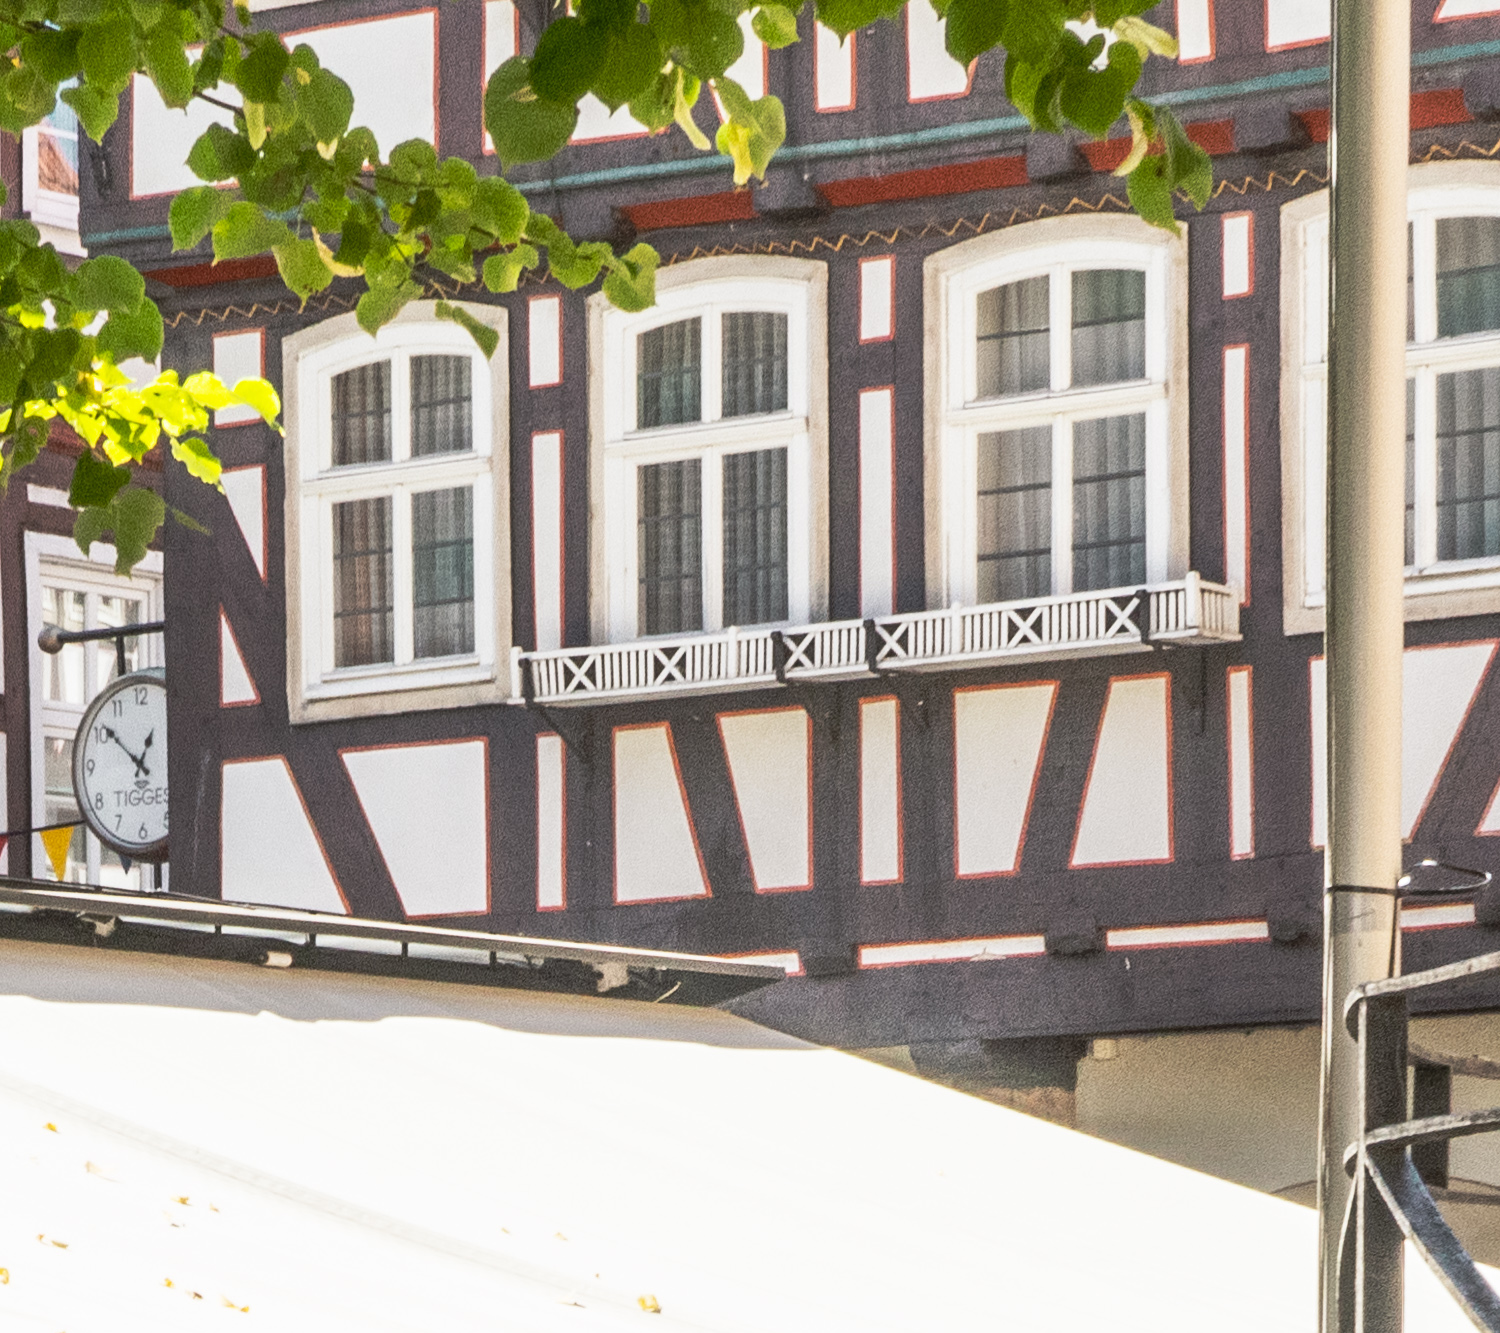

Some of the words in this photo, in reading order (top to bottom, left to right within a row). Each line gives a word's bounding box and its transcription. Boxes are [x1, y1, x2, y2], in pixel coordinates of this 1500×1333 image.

[134, 687, 148, 705] 12
[112, 700, 122, 717] 11
[86, 759, 95, 776] 9
[95, 793, 104, 810] 8
[115, 815, 122, 832] 7
[138, 823, 148, 839] 6
